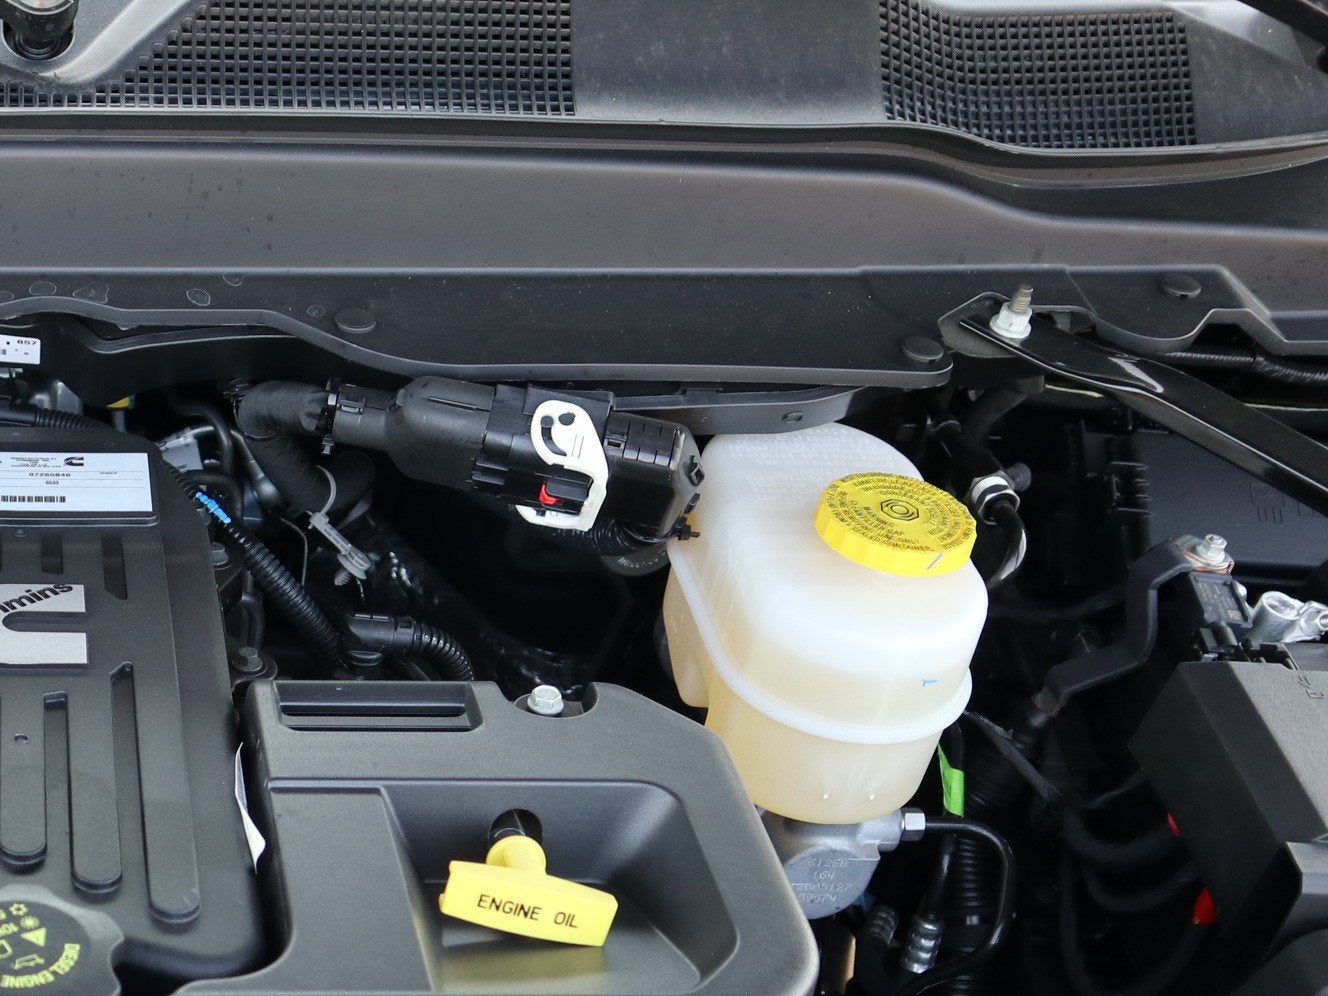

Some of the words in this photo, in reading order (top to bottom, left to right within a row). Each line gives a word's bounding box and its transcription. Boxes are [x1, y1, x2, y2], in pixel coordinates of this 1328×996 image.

[477, 894, 543, 921] ENGINE
[553, 911, 579, 929] OIL
[0, 970, 56, 989] ENGINE
